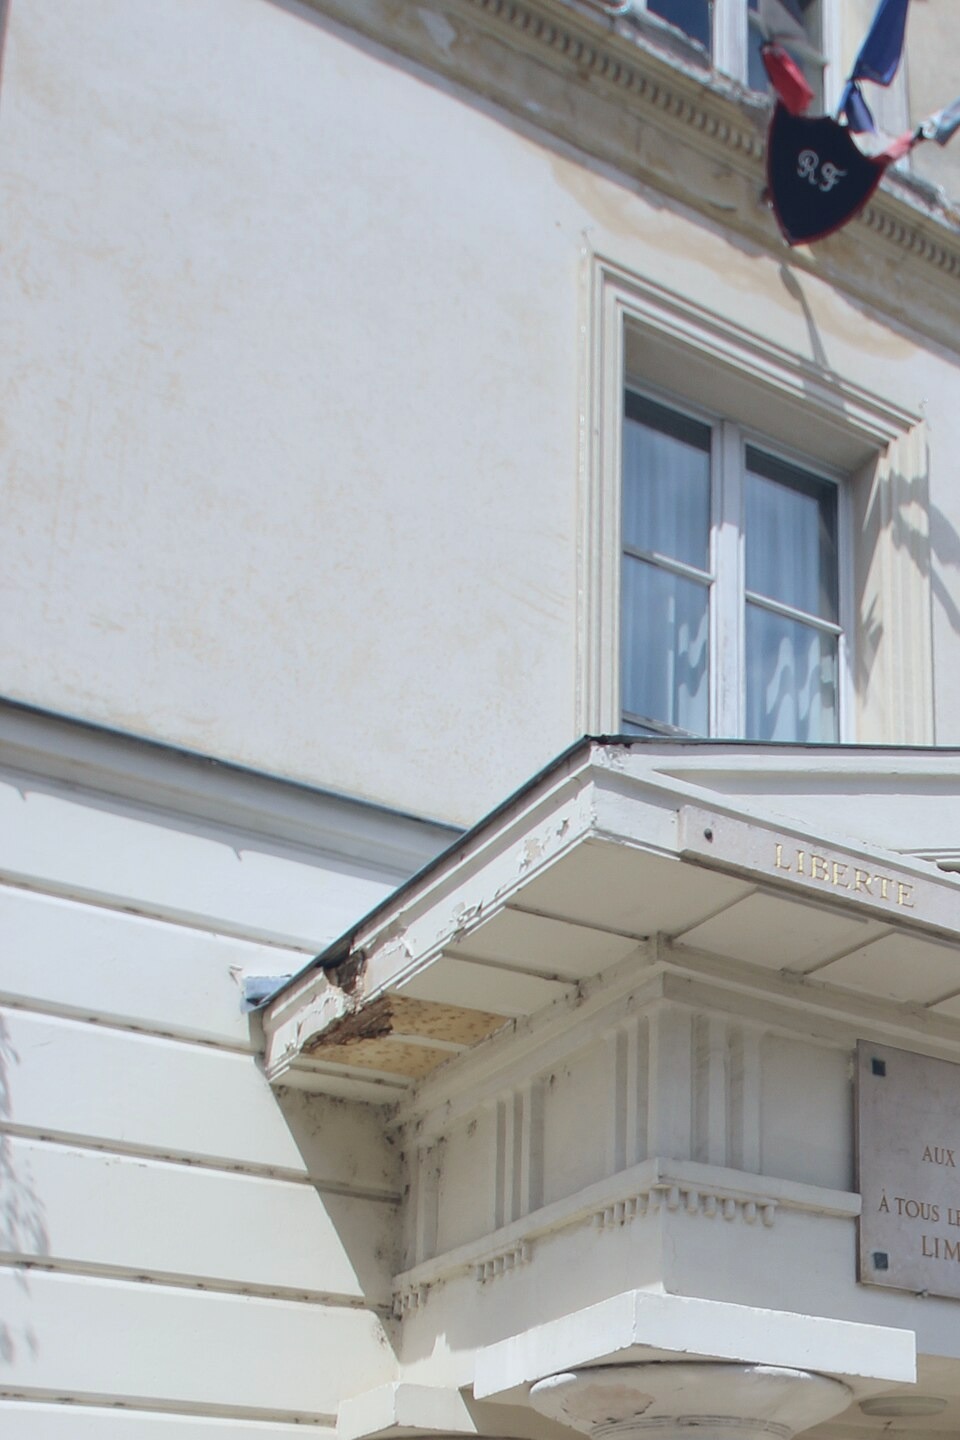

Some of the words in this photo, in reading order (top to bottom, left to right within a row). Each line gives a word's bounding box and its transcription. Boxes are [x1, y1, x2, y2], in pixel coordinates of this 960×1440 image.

[774, 842, 915, 908] LIBERTE
[921, 1145, 956, 1168] AUX
[894, 1196, 940, 1223] TOUS
